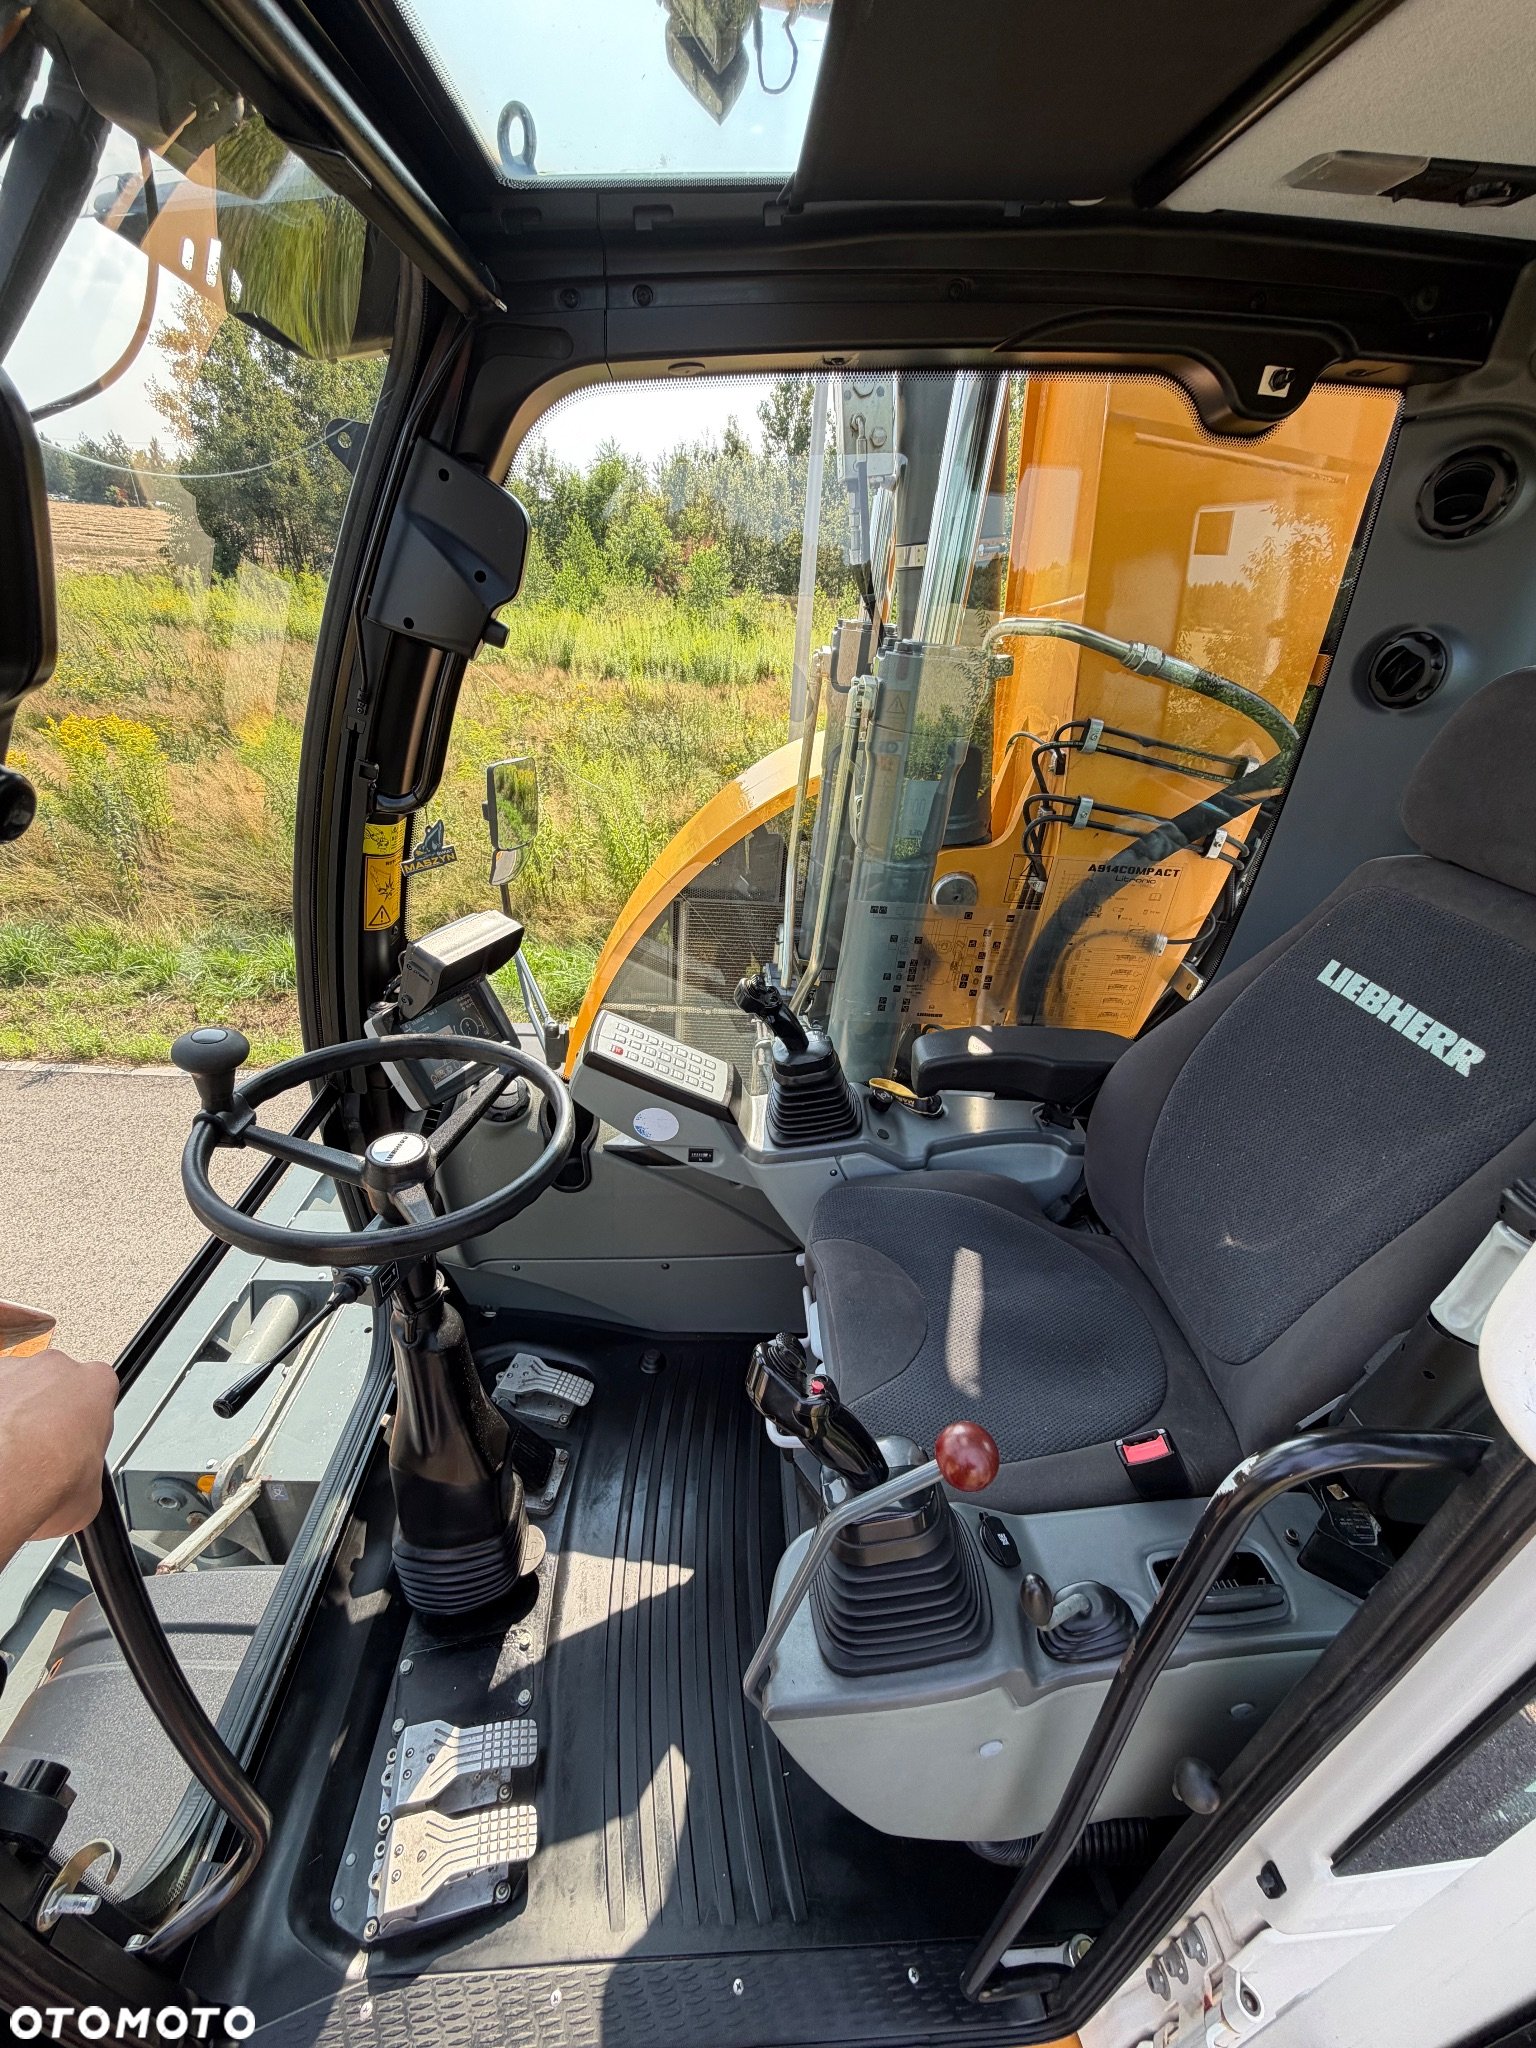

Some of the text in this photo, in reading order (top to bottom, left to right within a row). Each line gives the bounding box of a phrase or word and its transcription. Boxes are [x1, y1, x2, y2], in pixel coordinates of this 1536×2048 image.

[403, 853, 456, 873] MASZYN
[1088, 864, 1181, 877] A914COMPACT
[1317, 959, 1487, 1078] LIEBHERR
